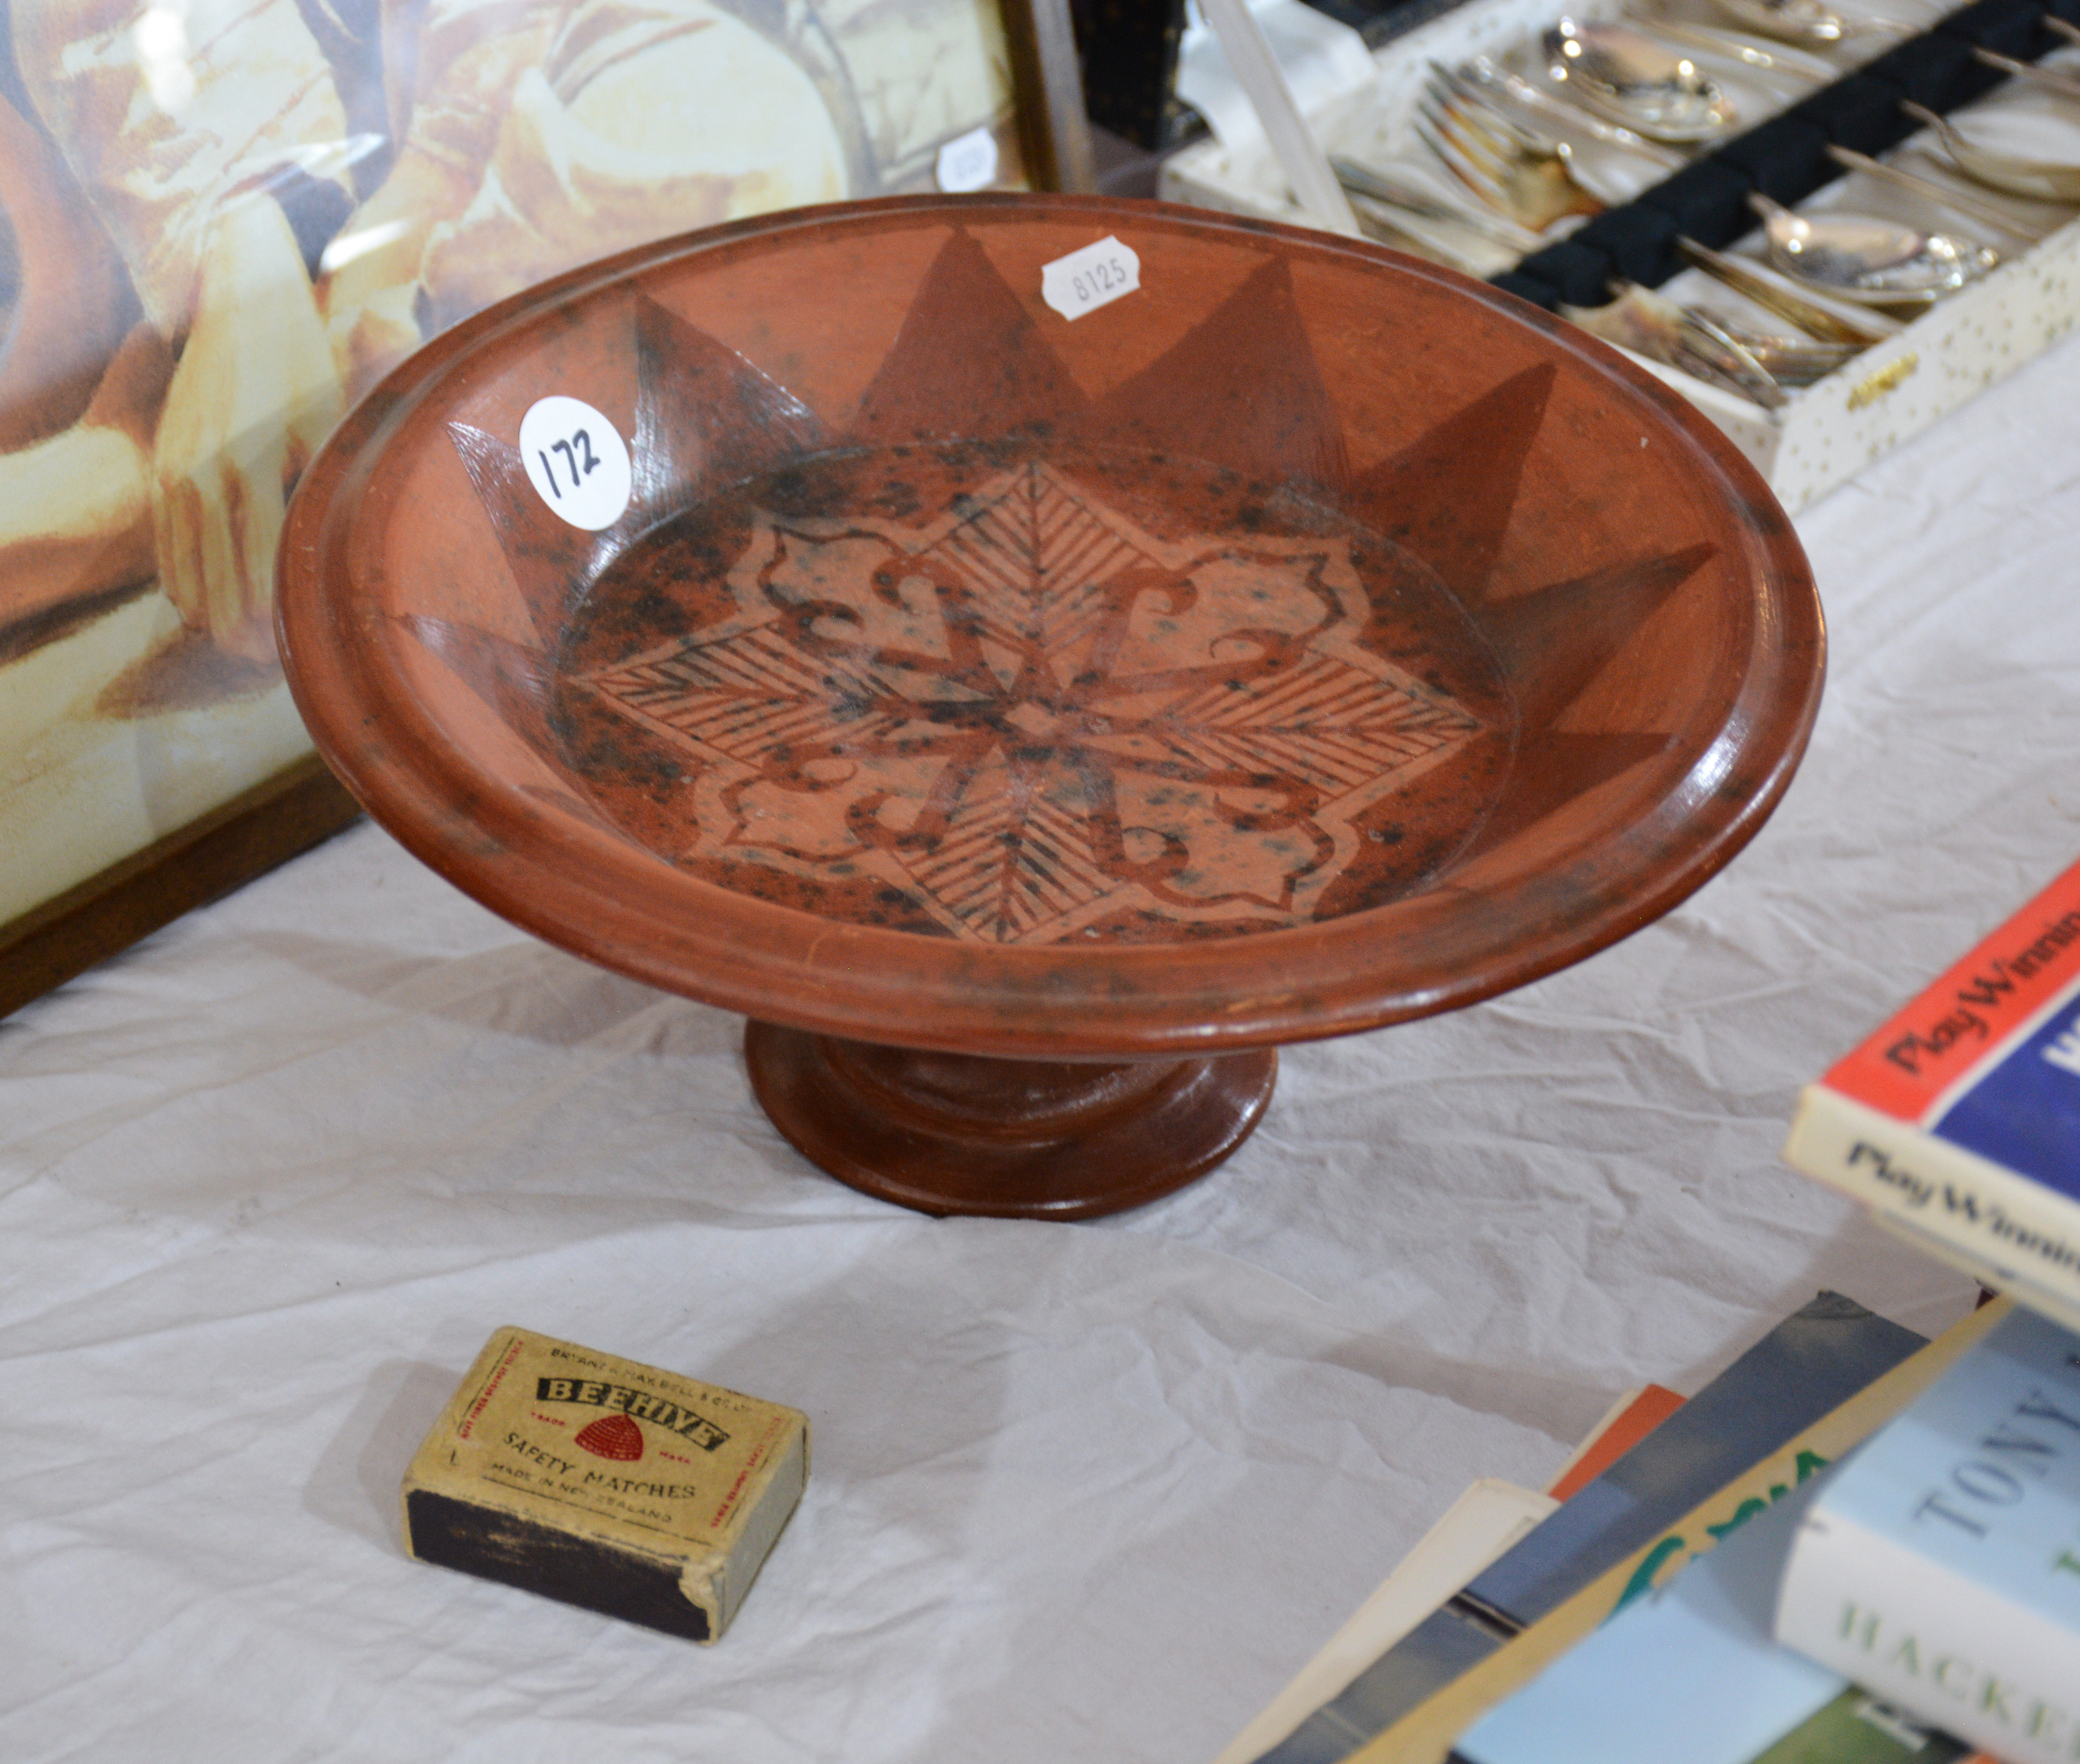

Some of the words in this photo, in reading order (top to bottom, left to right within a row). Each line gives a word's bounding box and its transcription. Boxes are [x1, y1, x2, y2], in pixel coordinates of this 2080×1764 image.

[1072, 258, 1126, 302] 8125
[538, 429, 601, 499] 172
[1883, 1007, 1990, 1075] Play
[1847, 1140, 1932, 1209] Play
[546, 1380, 727, 1448] BEEHIVE
[492, 1463, 531, 1481] MADE
[538, 1477, 554, 1487] IN
[503, 1431, 575, 1474] SAFETY
[583, 1471, 695, 1498] MATCHES
[1914, 1385, 2080, 1540] TONY
[1836, 1598, 2080, 1760] HACKE
